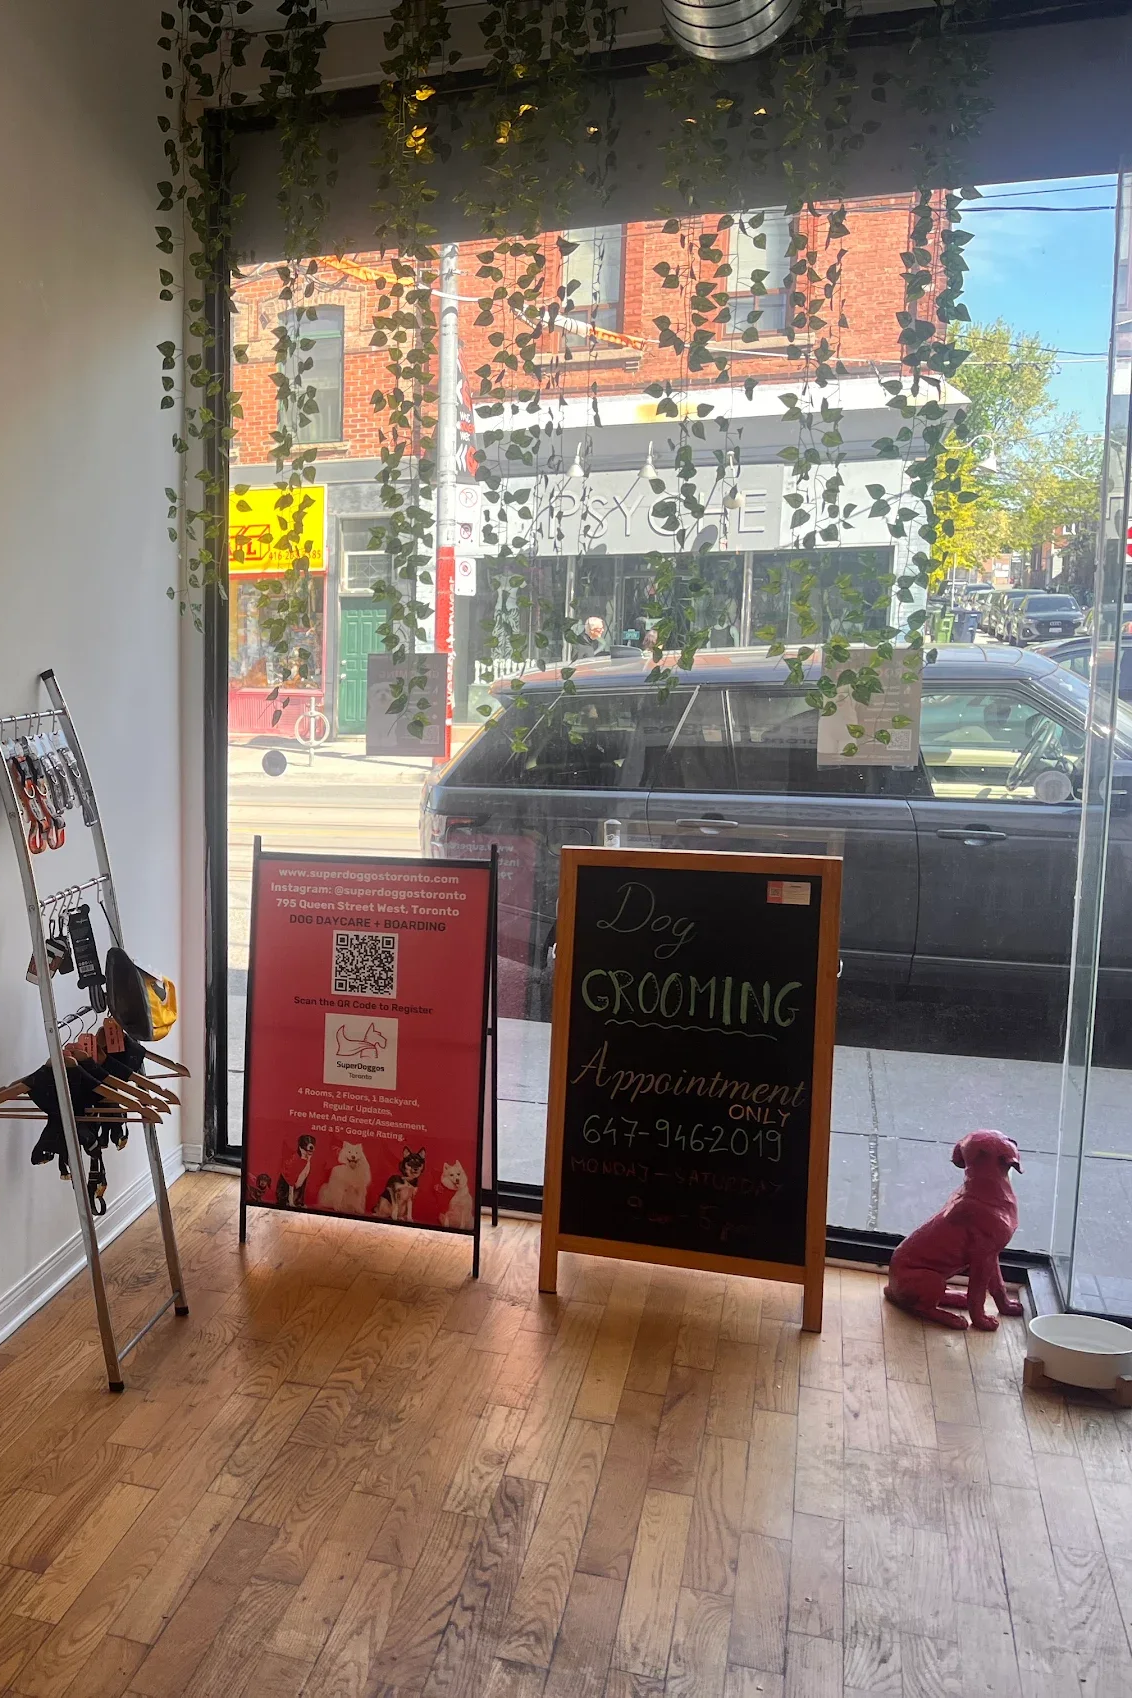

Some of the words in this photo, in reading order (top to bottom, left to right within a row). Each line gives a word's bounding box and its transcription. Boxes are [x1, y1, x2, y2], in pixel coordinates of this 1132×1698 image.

[279, 868, 459, 884] www.superdoggostoronto.com
[271, 882, 332, 895] Instagram:
[334, 886, 467, 900] @superdoggostoronto
[276, 898, 297, 908] 795
[299, 899, 335, 910] Queen
[337, 901, 375, 912] Street
[377, 903, 409, 914] West,
[411, 905, 460, 916] Toronto
[289, 914, 313, 924] DOG
[316, 915, 371, 928] DAYCARE
[384, 919, 446, 932] BOARDING
[596, 881, 697, 959] Dog
[294, 996, 317, 1006] Scan
[319, 998, 335, 1007] the
[337, 1000, 350, 1009] QR
[352, 1000, 377, 1010] Code
[379, 1003, 389, 1011] to
[391, 1004, 434, 1016] Register
[581, 968, 803, 1028] GROOMING
[336, 1061, 385, 1072] SuperDoggos
[349, 1072, 373, 1080] Toronto
[570, 1041, 806, 1108] Appointment
[297, 1087, 303, 1095] 4
[305, 1088, 334, 1099] Rooms,
[343, 1091, 370, 1101] Floors,
[372, 1094, 376, 1102] 1
[379, 1095, 420, 1107] Backyard,
[323, 1101, 354, 1112] Regular
[355, 1104, 393, 1116] Updates,
[729, 1104, 791, 1128] ONLY
[289, 1109, 307, 1118] Free
[309, 1110, 329, 1120] Meet
[331, 1113, 347, 1122] And
[348, 1115, 428, 1132] Greet/Assessment,
[311, 1123, 327, 1132] and
[345, 1127, 375, 1138] Google
[376, 1130, 405, 1141] Rating.
[582, 1114, 783, 1162] 647-946-2019
